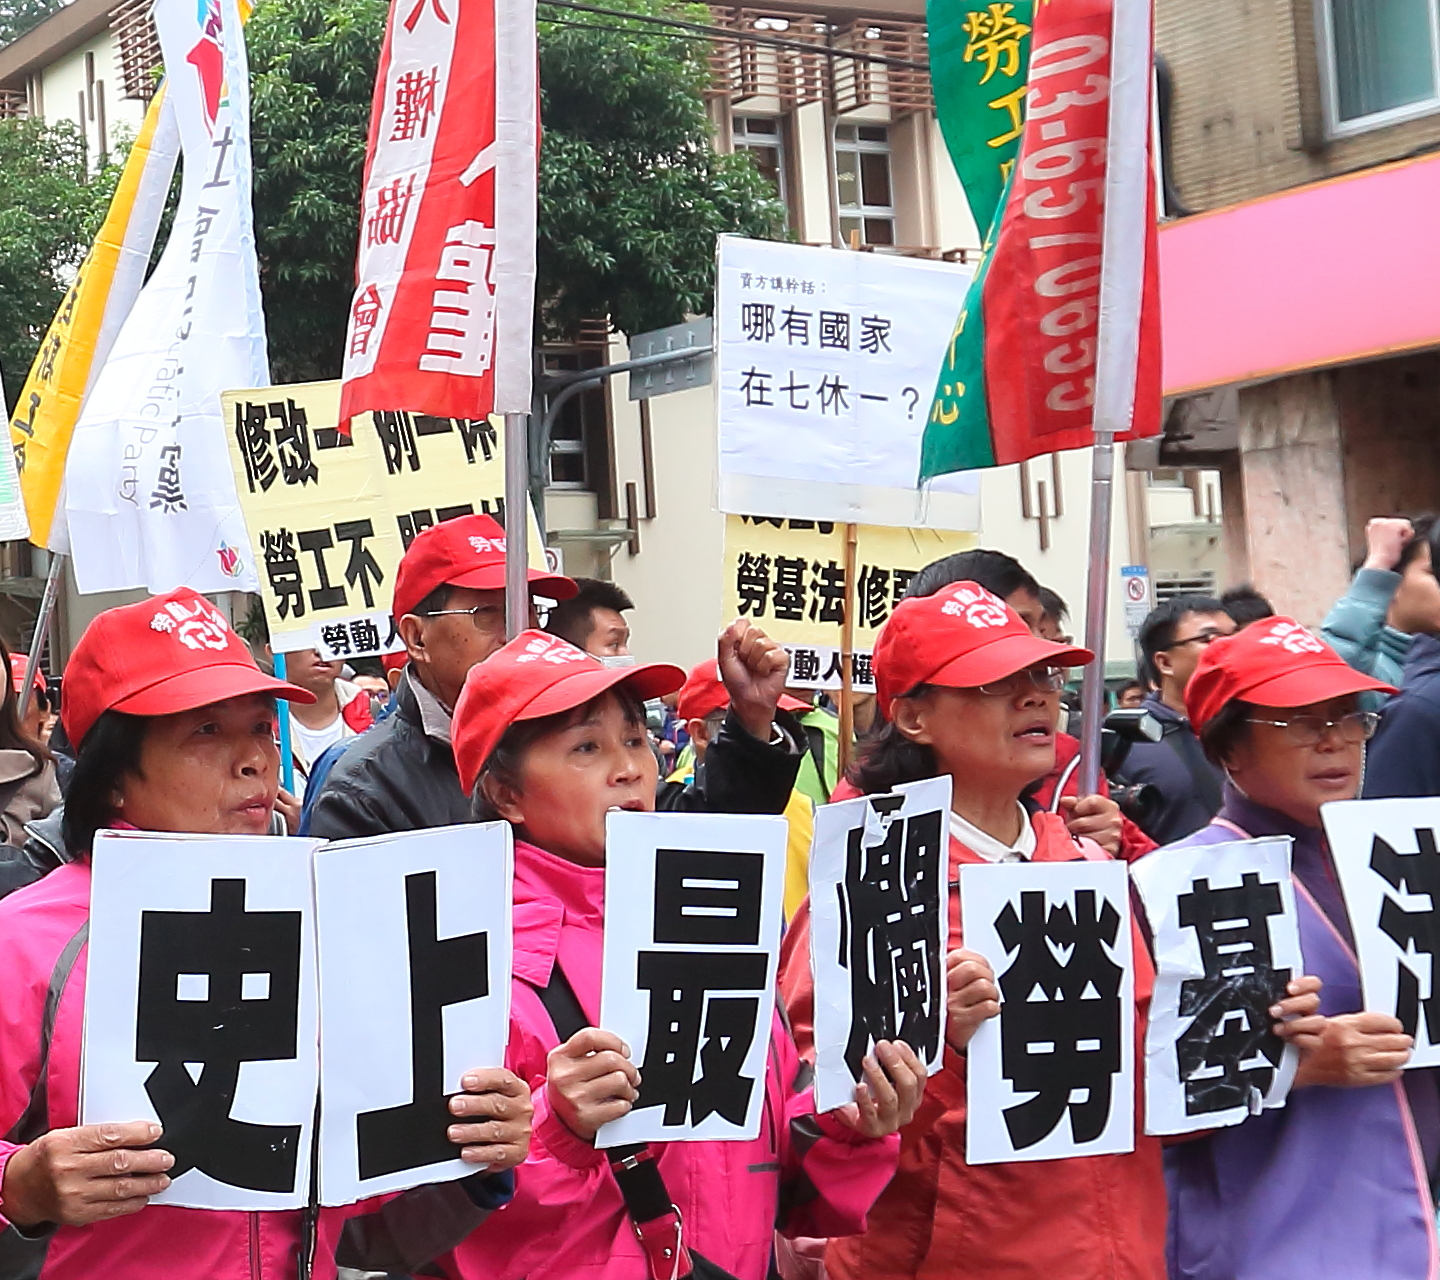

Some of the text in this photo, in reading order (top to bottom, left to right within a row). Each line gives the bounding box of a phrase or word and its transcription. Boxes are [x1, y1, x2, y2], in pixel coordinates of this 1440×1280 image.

[741, 302, 893, 354] 哪有國家
[260, 518, 385, 621] 勞工不
[785, 648, 874, 685] 動人權
[136, 878, 303, 1194] 史
[356, 870, 490, 1181] 上
[632, 848, 770, 1128] 最
[837, 792, 945, 1085] 爛
[993, 889, 1124, 1152] 勞
[1176, 871, 1291, 1118] 基
